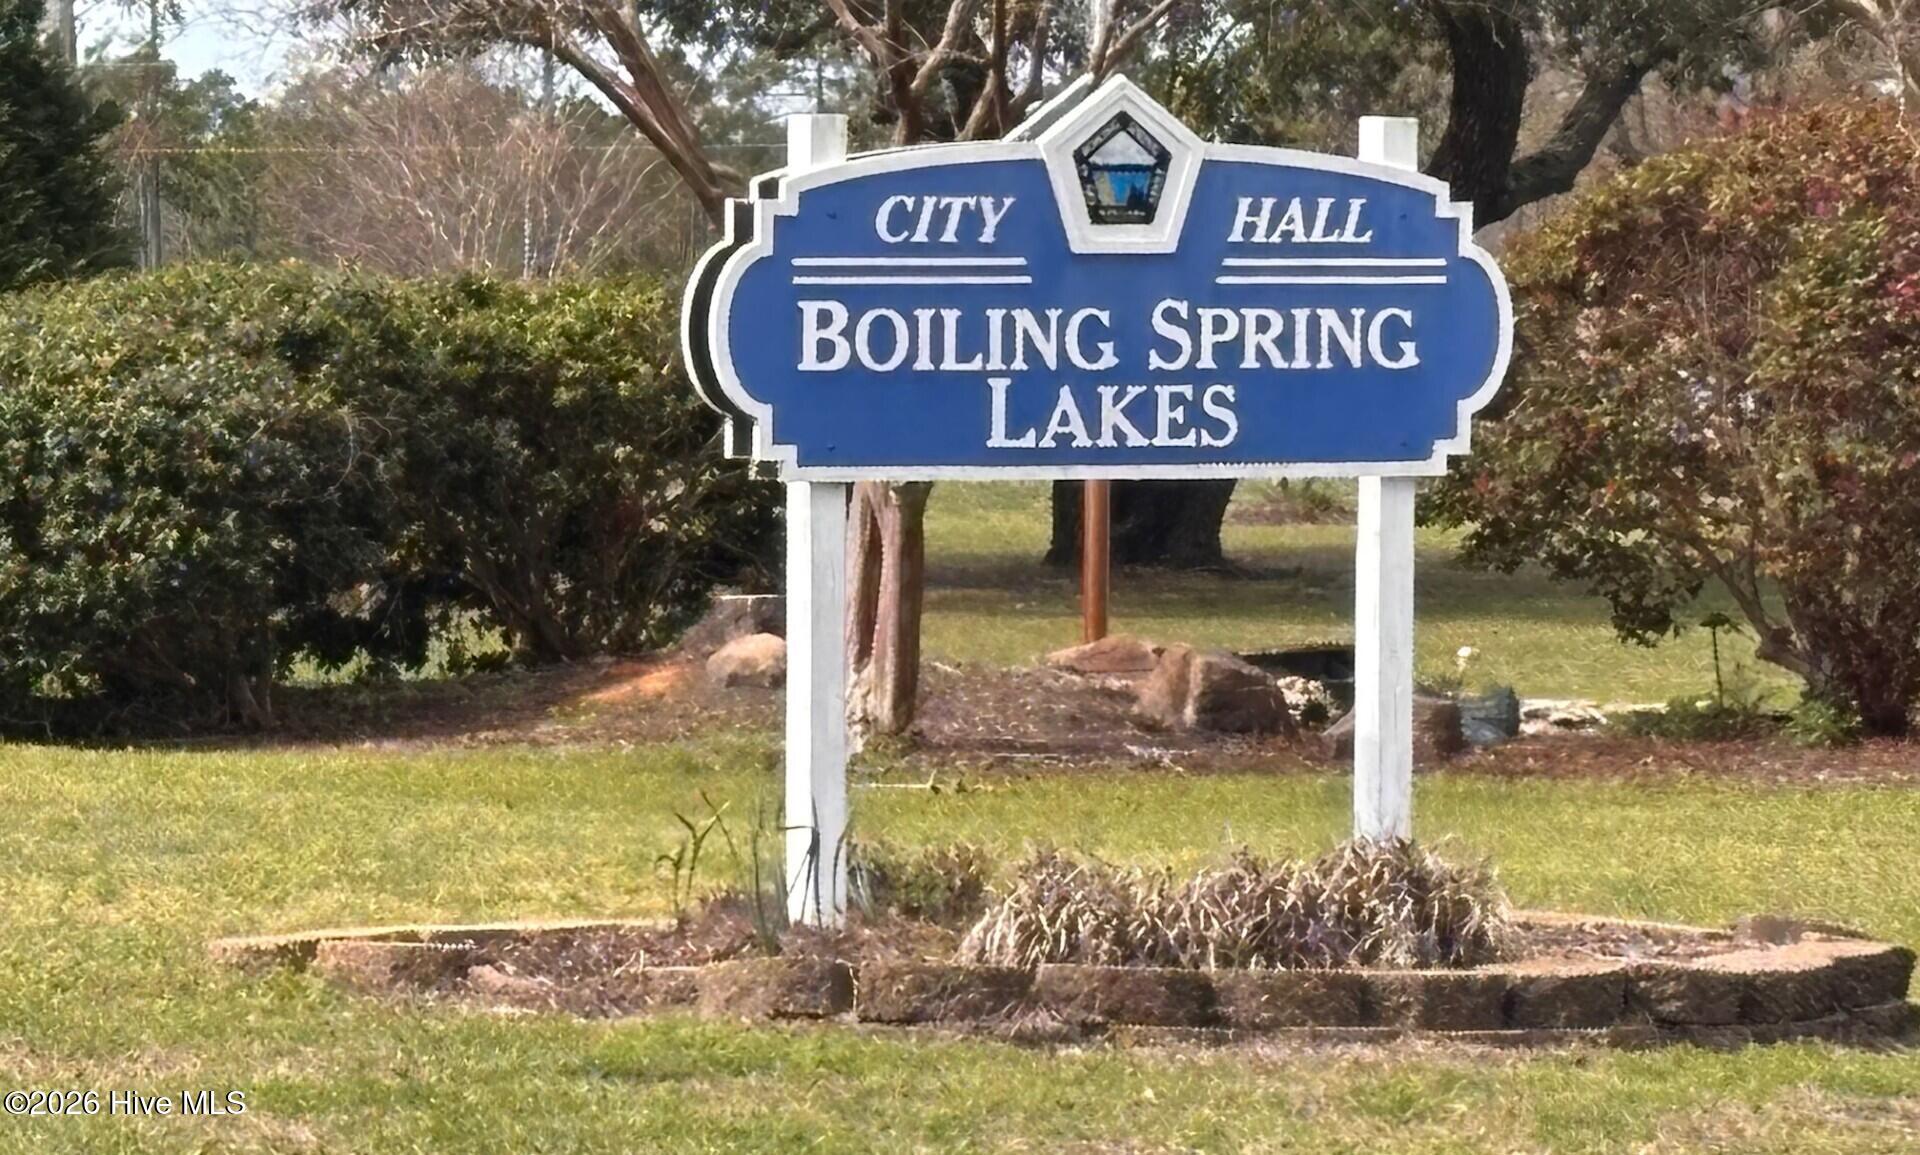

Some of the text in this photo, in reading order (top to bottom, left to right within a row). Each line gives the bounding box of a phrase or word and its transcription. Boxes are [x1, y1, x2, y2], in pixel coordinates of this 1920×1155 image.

[874, 195, 1373, 244] CITY HALL
[797, 298, 1420, 372] BOILING SPRING
[986, 376, 1239, 448] LAKES
